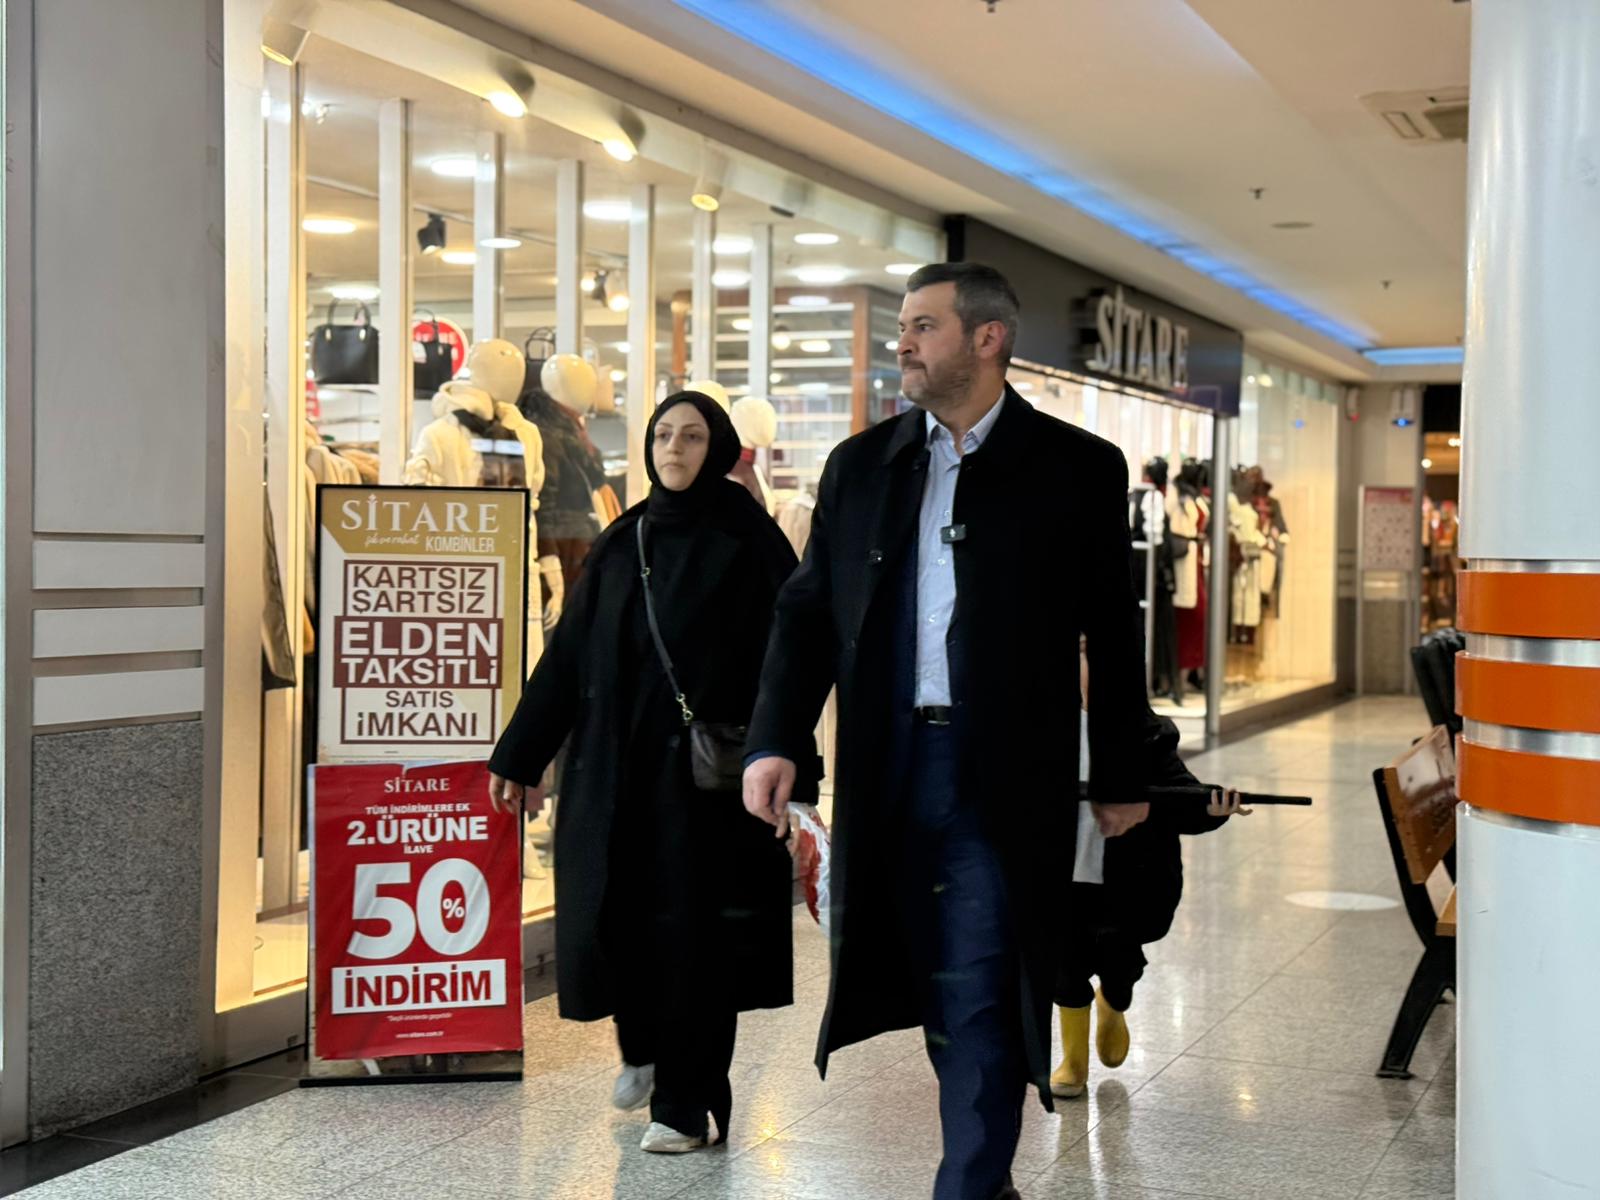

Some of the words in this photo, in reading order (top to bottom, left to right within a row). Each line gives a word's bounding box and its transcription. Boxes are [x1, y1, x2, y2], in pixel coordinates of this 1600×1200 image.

[341, 493, 499, 534] SİTARE
[425, 535, 495, 553] KOMBİNLER
[353, 566, 486, 590] KARTSIZ
[352, 590, 485, 614] ŞARTSIZ
[341, 621, 498, 657] ELDEN
[385, 690, 454, 708] SATIŞ
[384, 777, 450, 793] SİTARE
[365, 804, 388, 815] TÜM
[390, 803, 454, 814] İNDİRİMLERE
[456, 802, 471, 812] EK
[347, 812, 489, 846] 2.ÜRÜNE
[403, 844, 434, 854] İLAVE
[347, 857, 491, 960] 50
[442, 898, 465, 919] %
[344, 964, 492, 1009] İNDİRİM
